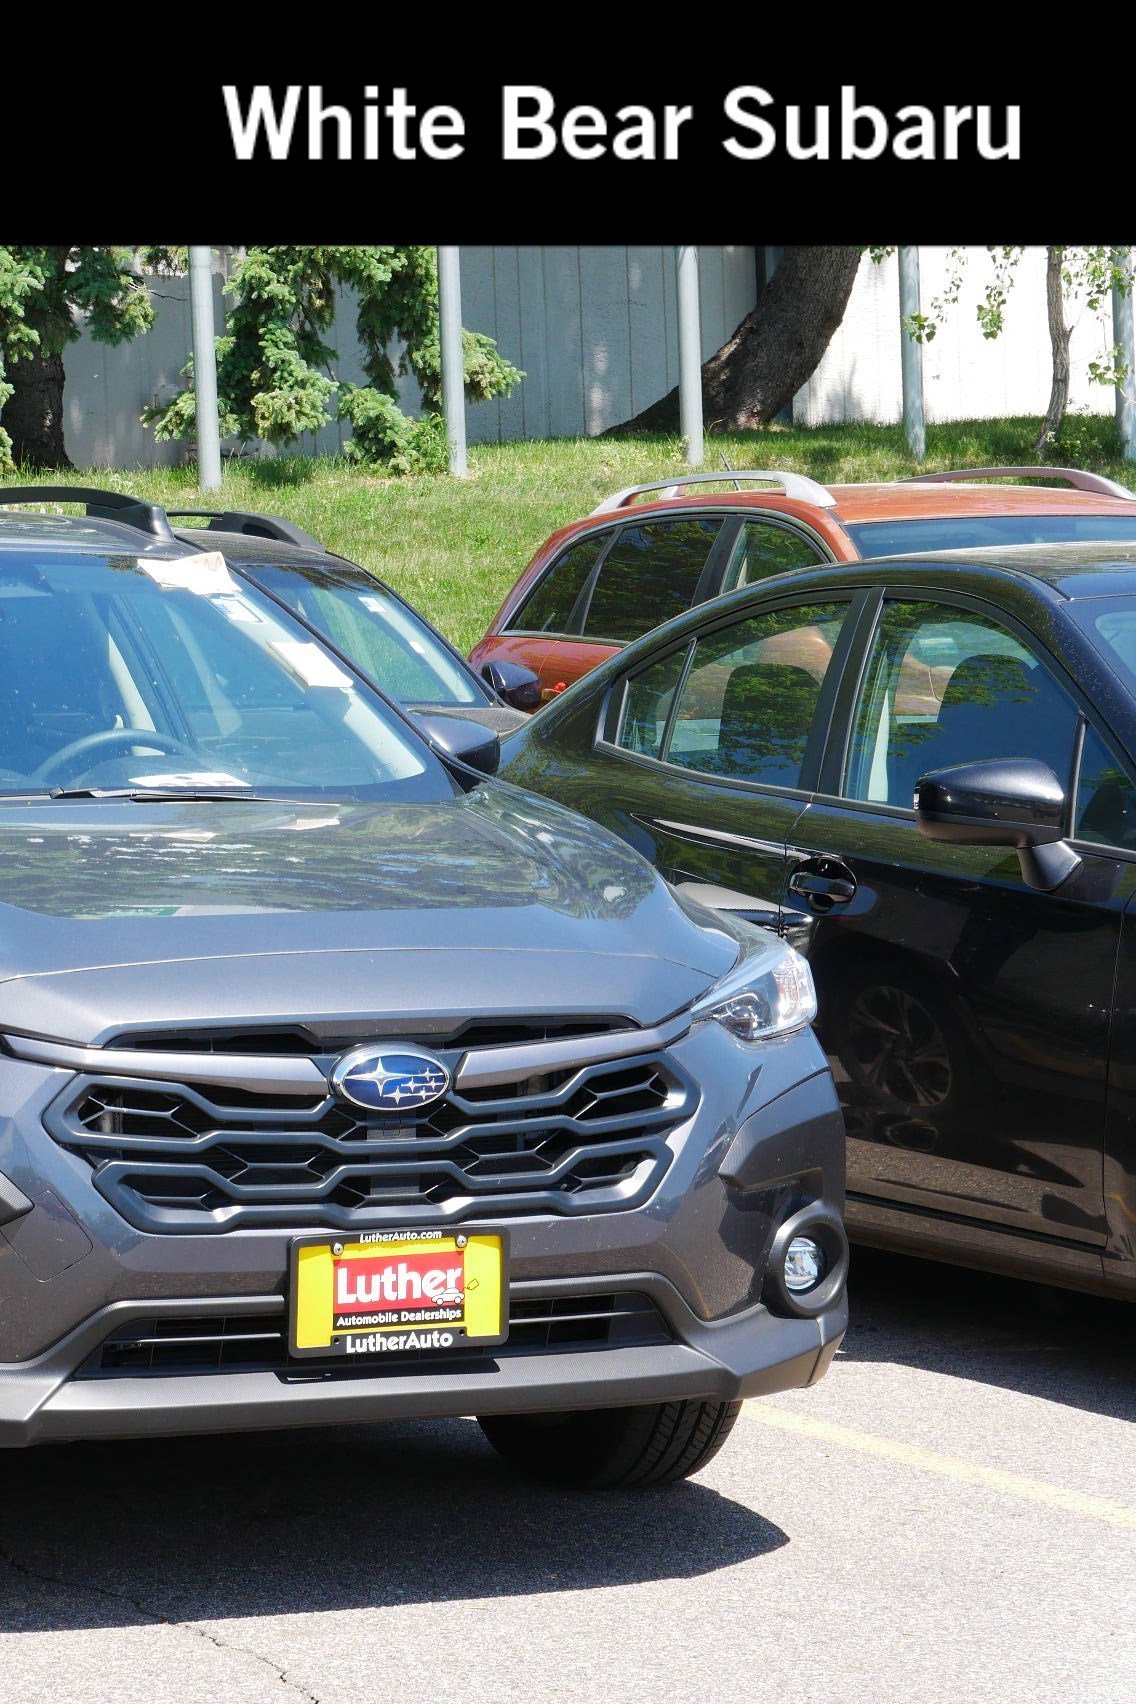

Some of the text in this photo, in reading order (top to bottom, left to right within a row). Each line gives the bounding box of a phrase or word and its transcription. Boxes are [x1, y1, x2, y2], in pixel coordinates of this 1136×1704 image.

[359, 1230, 442, 1244] LutherAuto.com
[337, 1262, 462, 1304] Luther
[336, 1307, 462, 1328] Automobile Dealerships
[346, 1331, 454, 1354] LutherAuto
